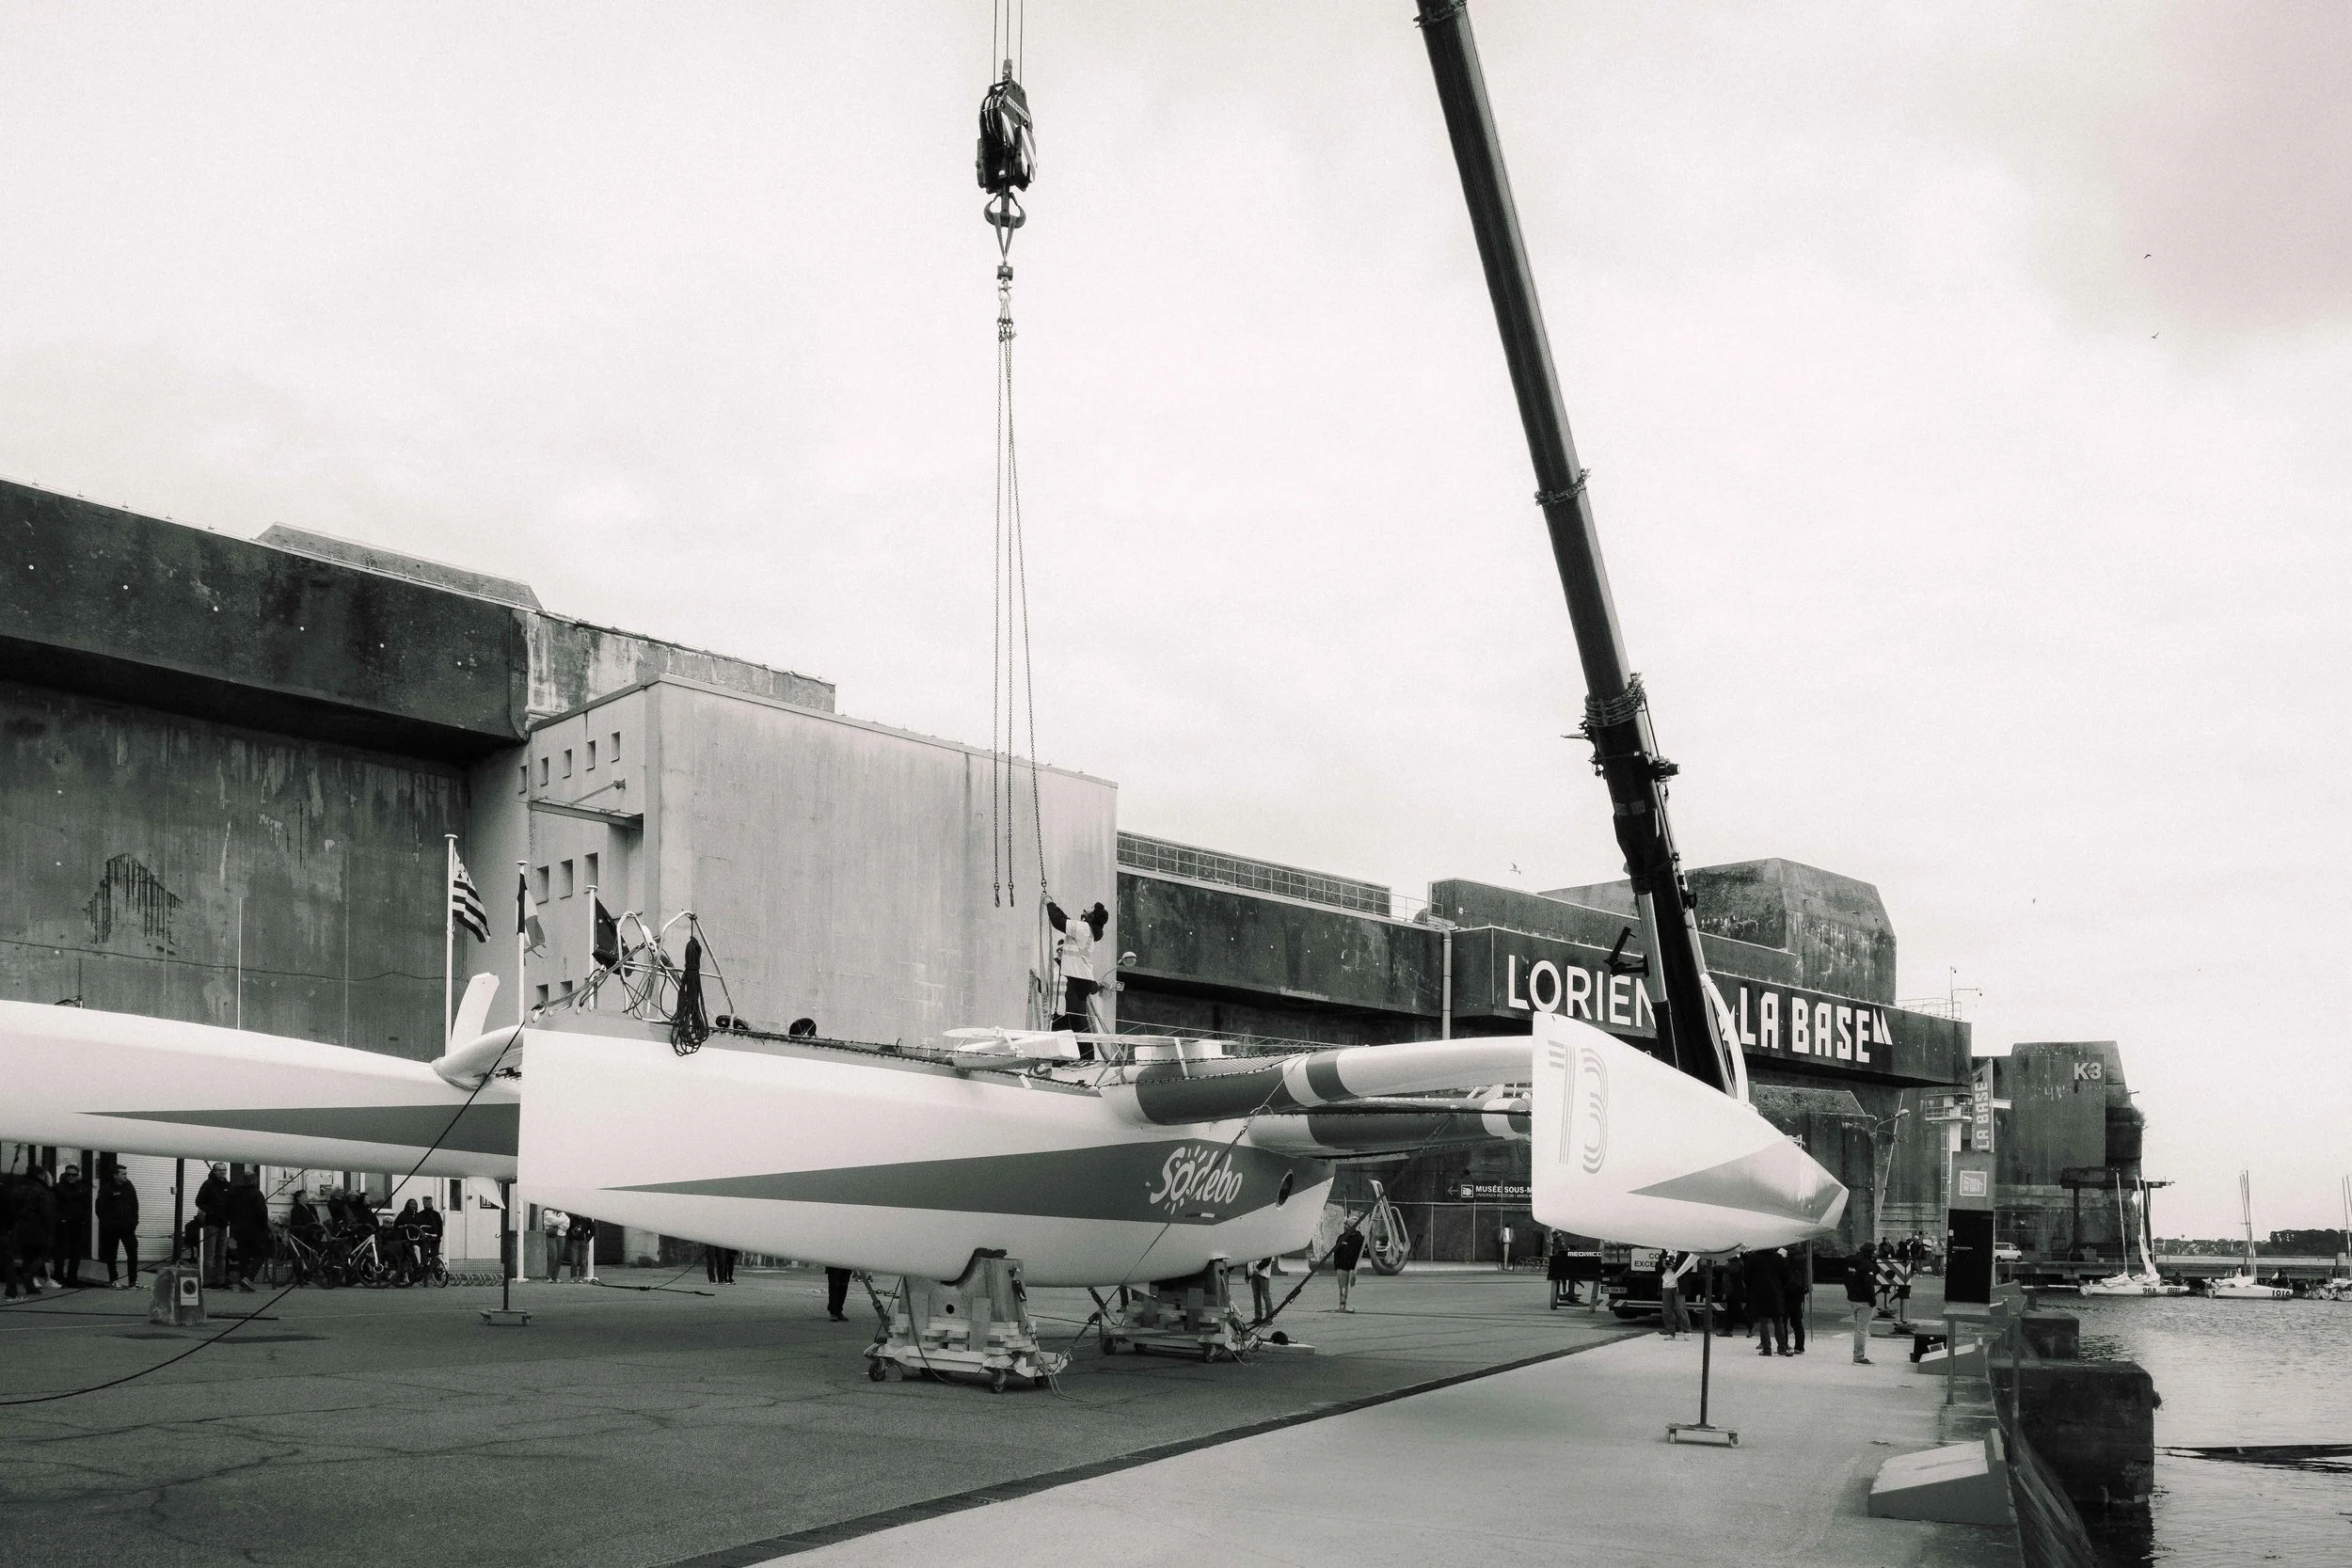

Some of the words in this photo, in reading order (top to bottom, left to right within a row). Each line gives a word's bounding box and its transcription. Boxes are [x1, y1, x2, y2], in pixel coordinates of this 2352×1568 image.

[1508, 955, 1657, 1029] LORIEN
[1740, 987, 1779, 1049] LA
[1791, 997, 1870, 1063] BASE
[2074, 1062, 2102, 1080] K3
[1975, 1082, 1989, 1125] BASE
[1976, 1129, 1990, 1150] LA
